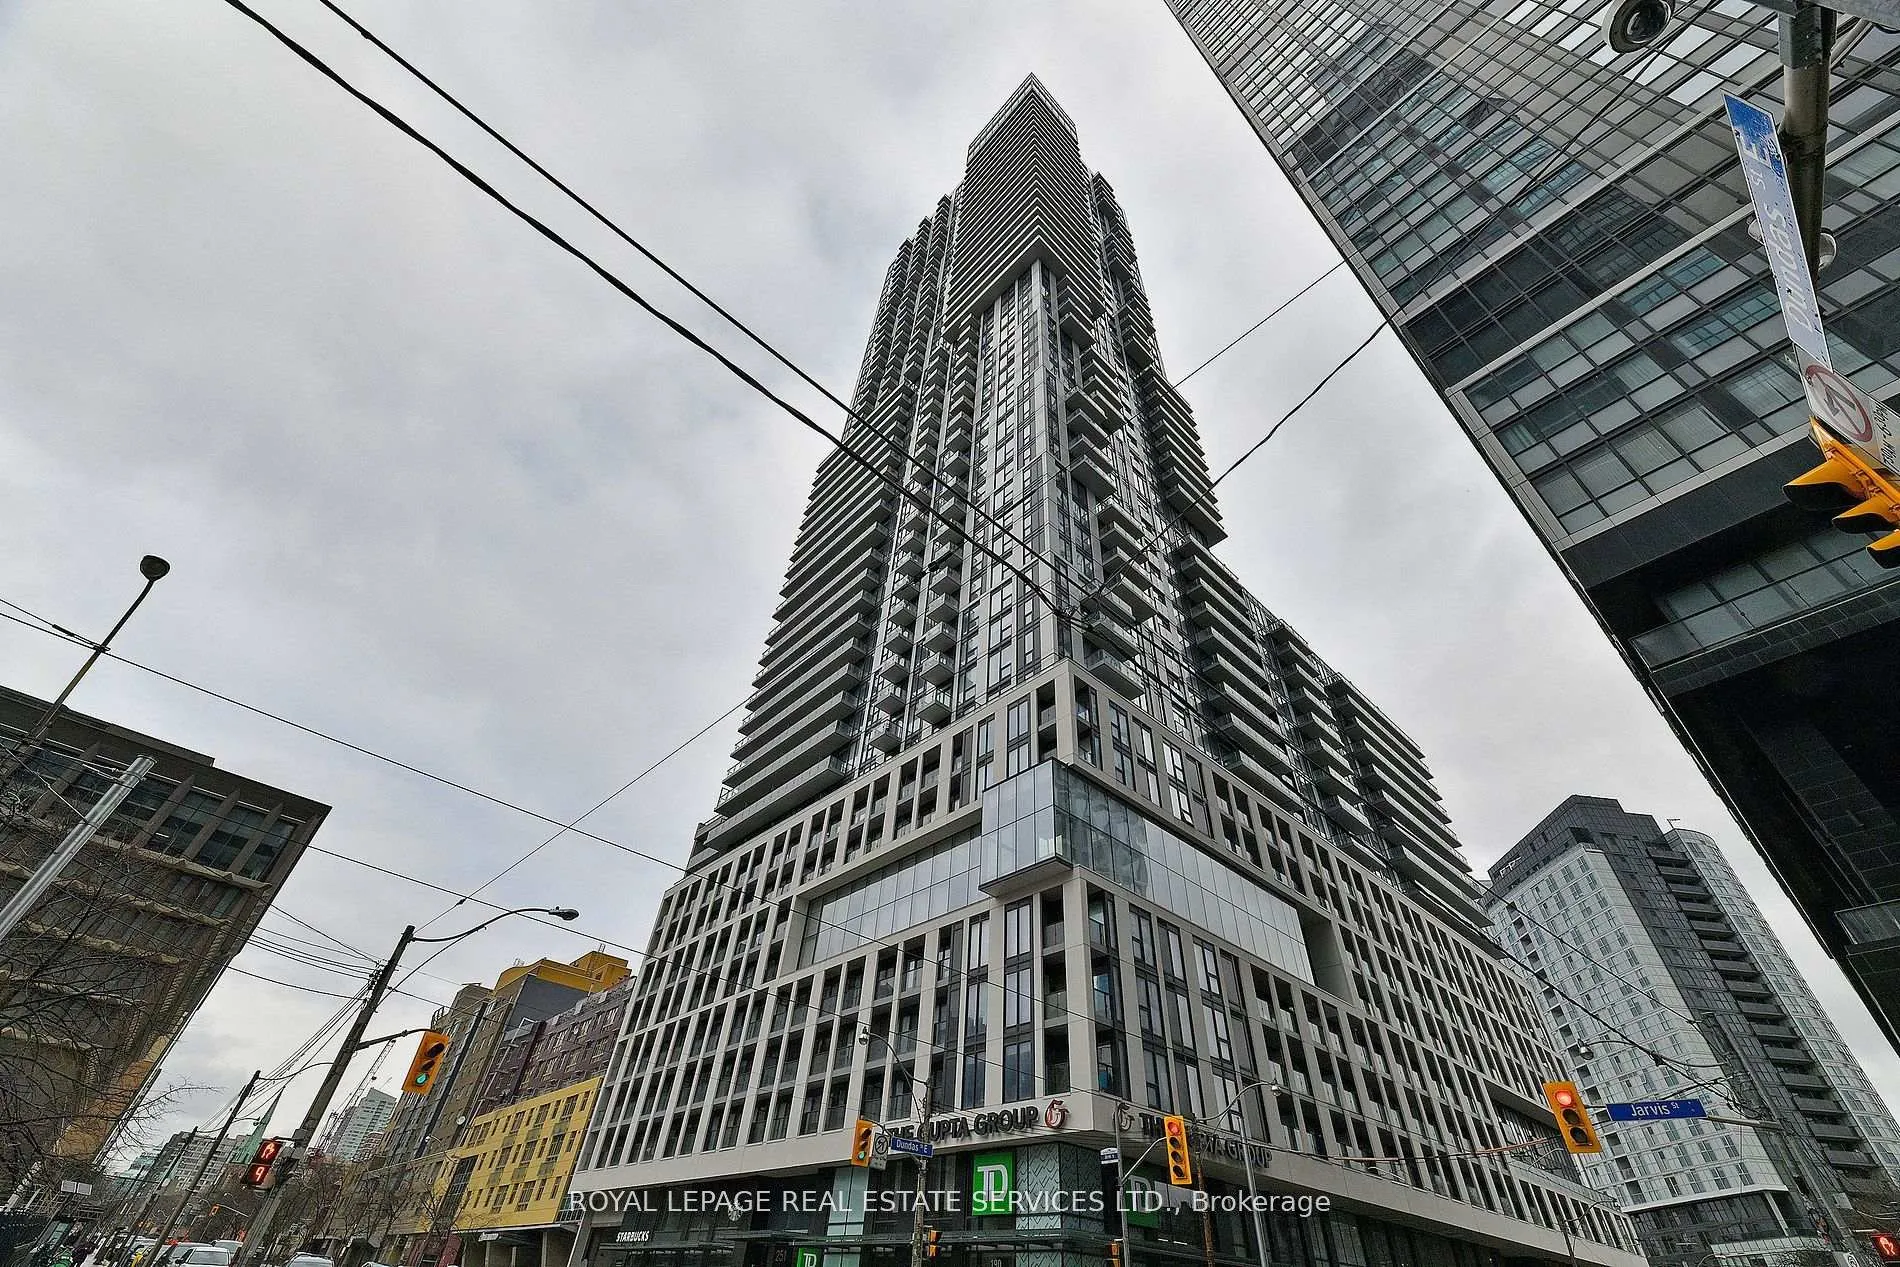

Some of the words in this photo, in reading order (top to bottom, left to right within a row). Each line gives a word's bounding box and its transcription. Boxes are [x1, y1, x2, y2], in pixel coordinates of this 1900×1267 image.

[1739, 136, 1770, 167] E
[1750, 168, 1766, 192] St
[1764, 203, 1812, 333] Dundas
[974, 1106, 1038, 1136] GROUP
[1631, 1102, 1671, 1117] Jarvis
[1671, 1101, 1680, 1109] St
[1139, 1113, 1165, 1137] TH
[896, 1139, 919, 1152] Dundas
[924, 1144, 928, 1153] E
[255, 1166, 265, 1182] 9
[977, 1164, 1008, 1202] TD
[615, 1230, 650, 1242] STARBUCKS
